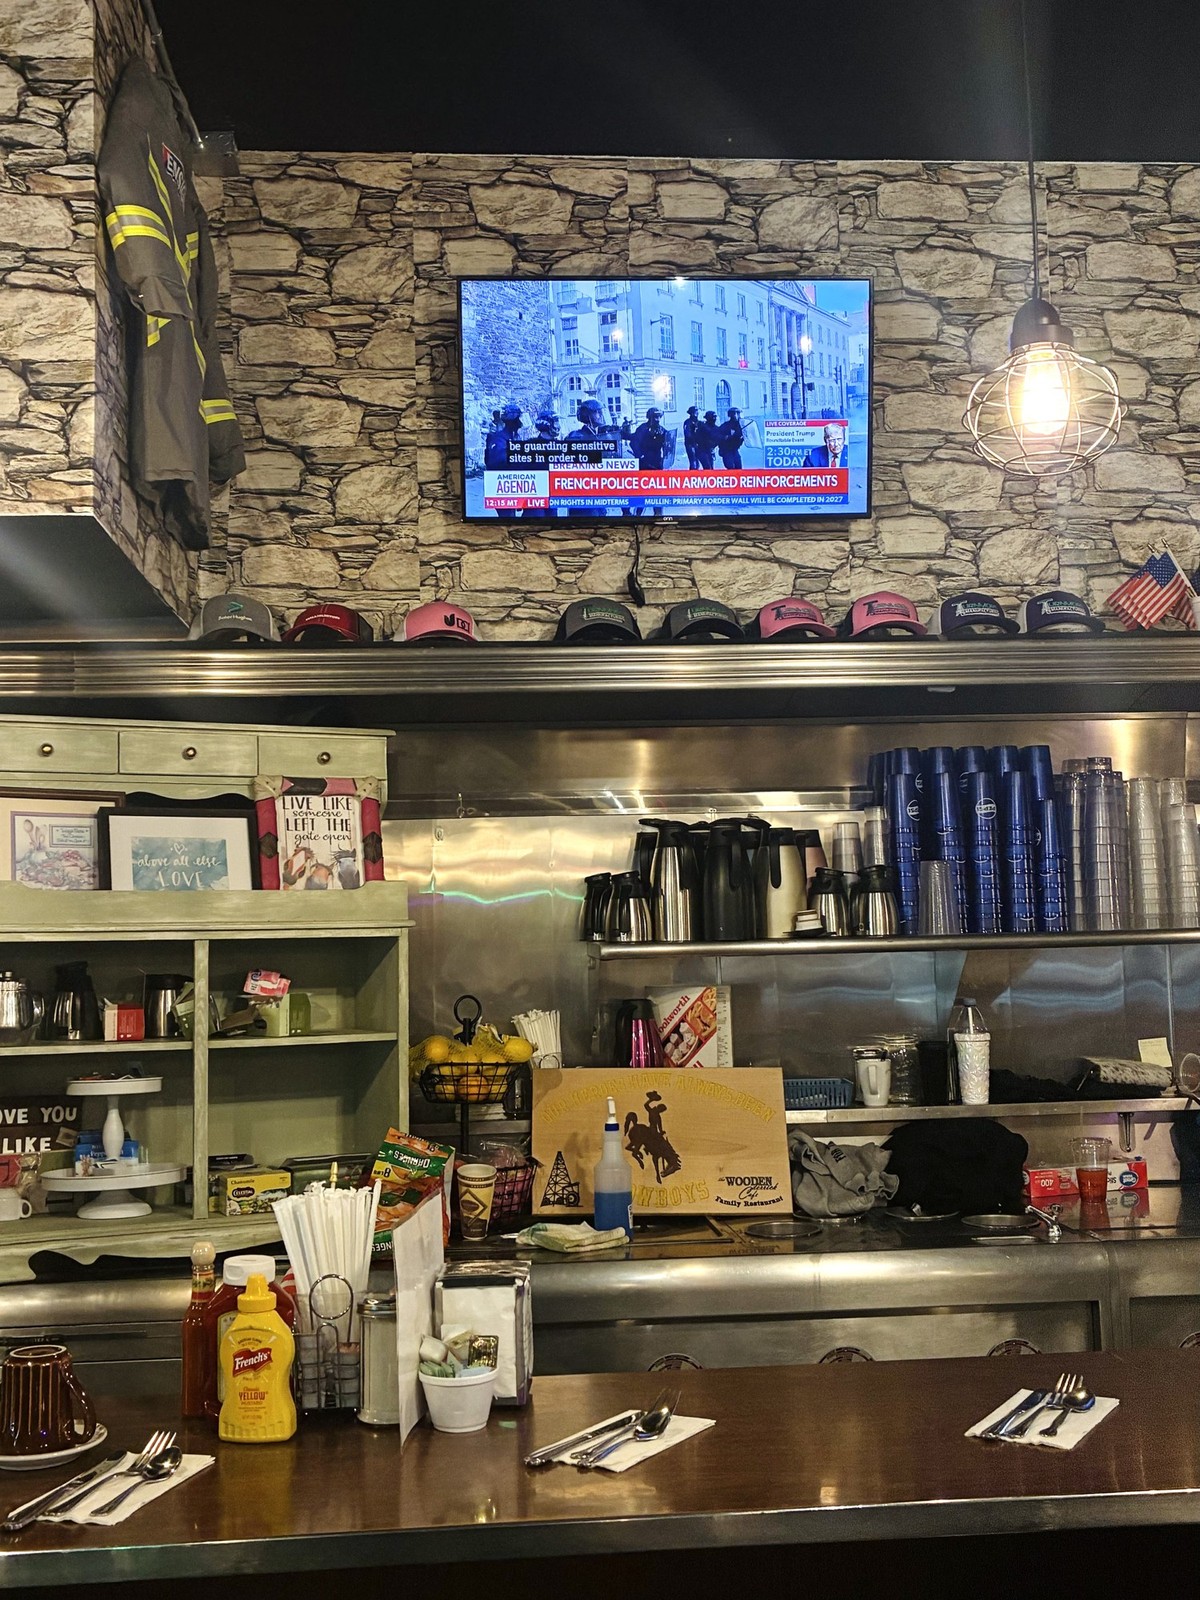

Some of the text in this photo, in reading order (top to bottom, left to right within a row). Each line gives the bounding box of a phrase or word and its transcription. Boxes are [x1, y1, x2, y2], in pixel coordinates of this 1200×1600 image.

[509, 441, 615, 453] be guarding sensitive
[509, 454, 588, 463] sites in order to
[606, 460, 636, 469] NEWS
[767, 456, 806, 467] TODAY
[496, 480, 537, 494] AGENDA
[554, 474, 838, 490] FRENCH POLICE CALL IN ARMORED REINFORCEMENTS
[527, 499, 546, 507] LIVE
[672, 497, 702, 505] PRIMARY
[703, 497, 730, 505] BORDER
[750, 496, 766, 504] WILL
[767, 496, 776, 504] BE
[826, 495, 844, 503] 2027
[283, 796, 353, 810] LIVE LIKE
[286, 818, 351, 832] LEFT THE
[294, 831, 352, 848] gate open
[137, 855, 221, 867] above all else
[158, 871, 203, 888] LOVE
[659, 995, 691, 1033] oolworth
[631, 1072, 672, 1087] HAVE
[676, 1075, 732, 1102] ALWAYS
[734, 1090, 777, 1122] BEEN
[0, 1105, 78, 1124] VE YOU
[2, 1136, 52, 1154] LIKE
[725, 1176, 773, 1186] WOODEN
[632, 1180, 710, 1208] WBOYS
[715, 1195, 784, 1208] Family Restaurant
[234, 1351, 268, 1370] French's
[239, 1392, 265, 1401] YELLOW
